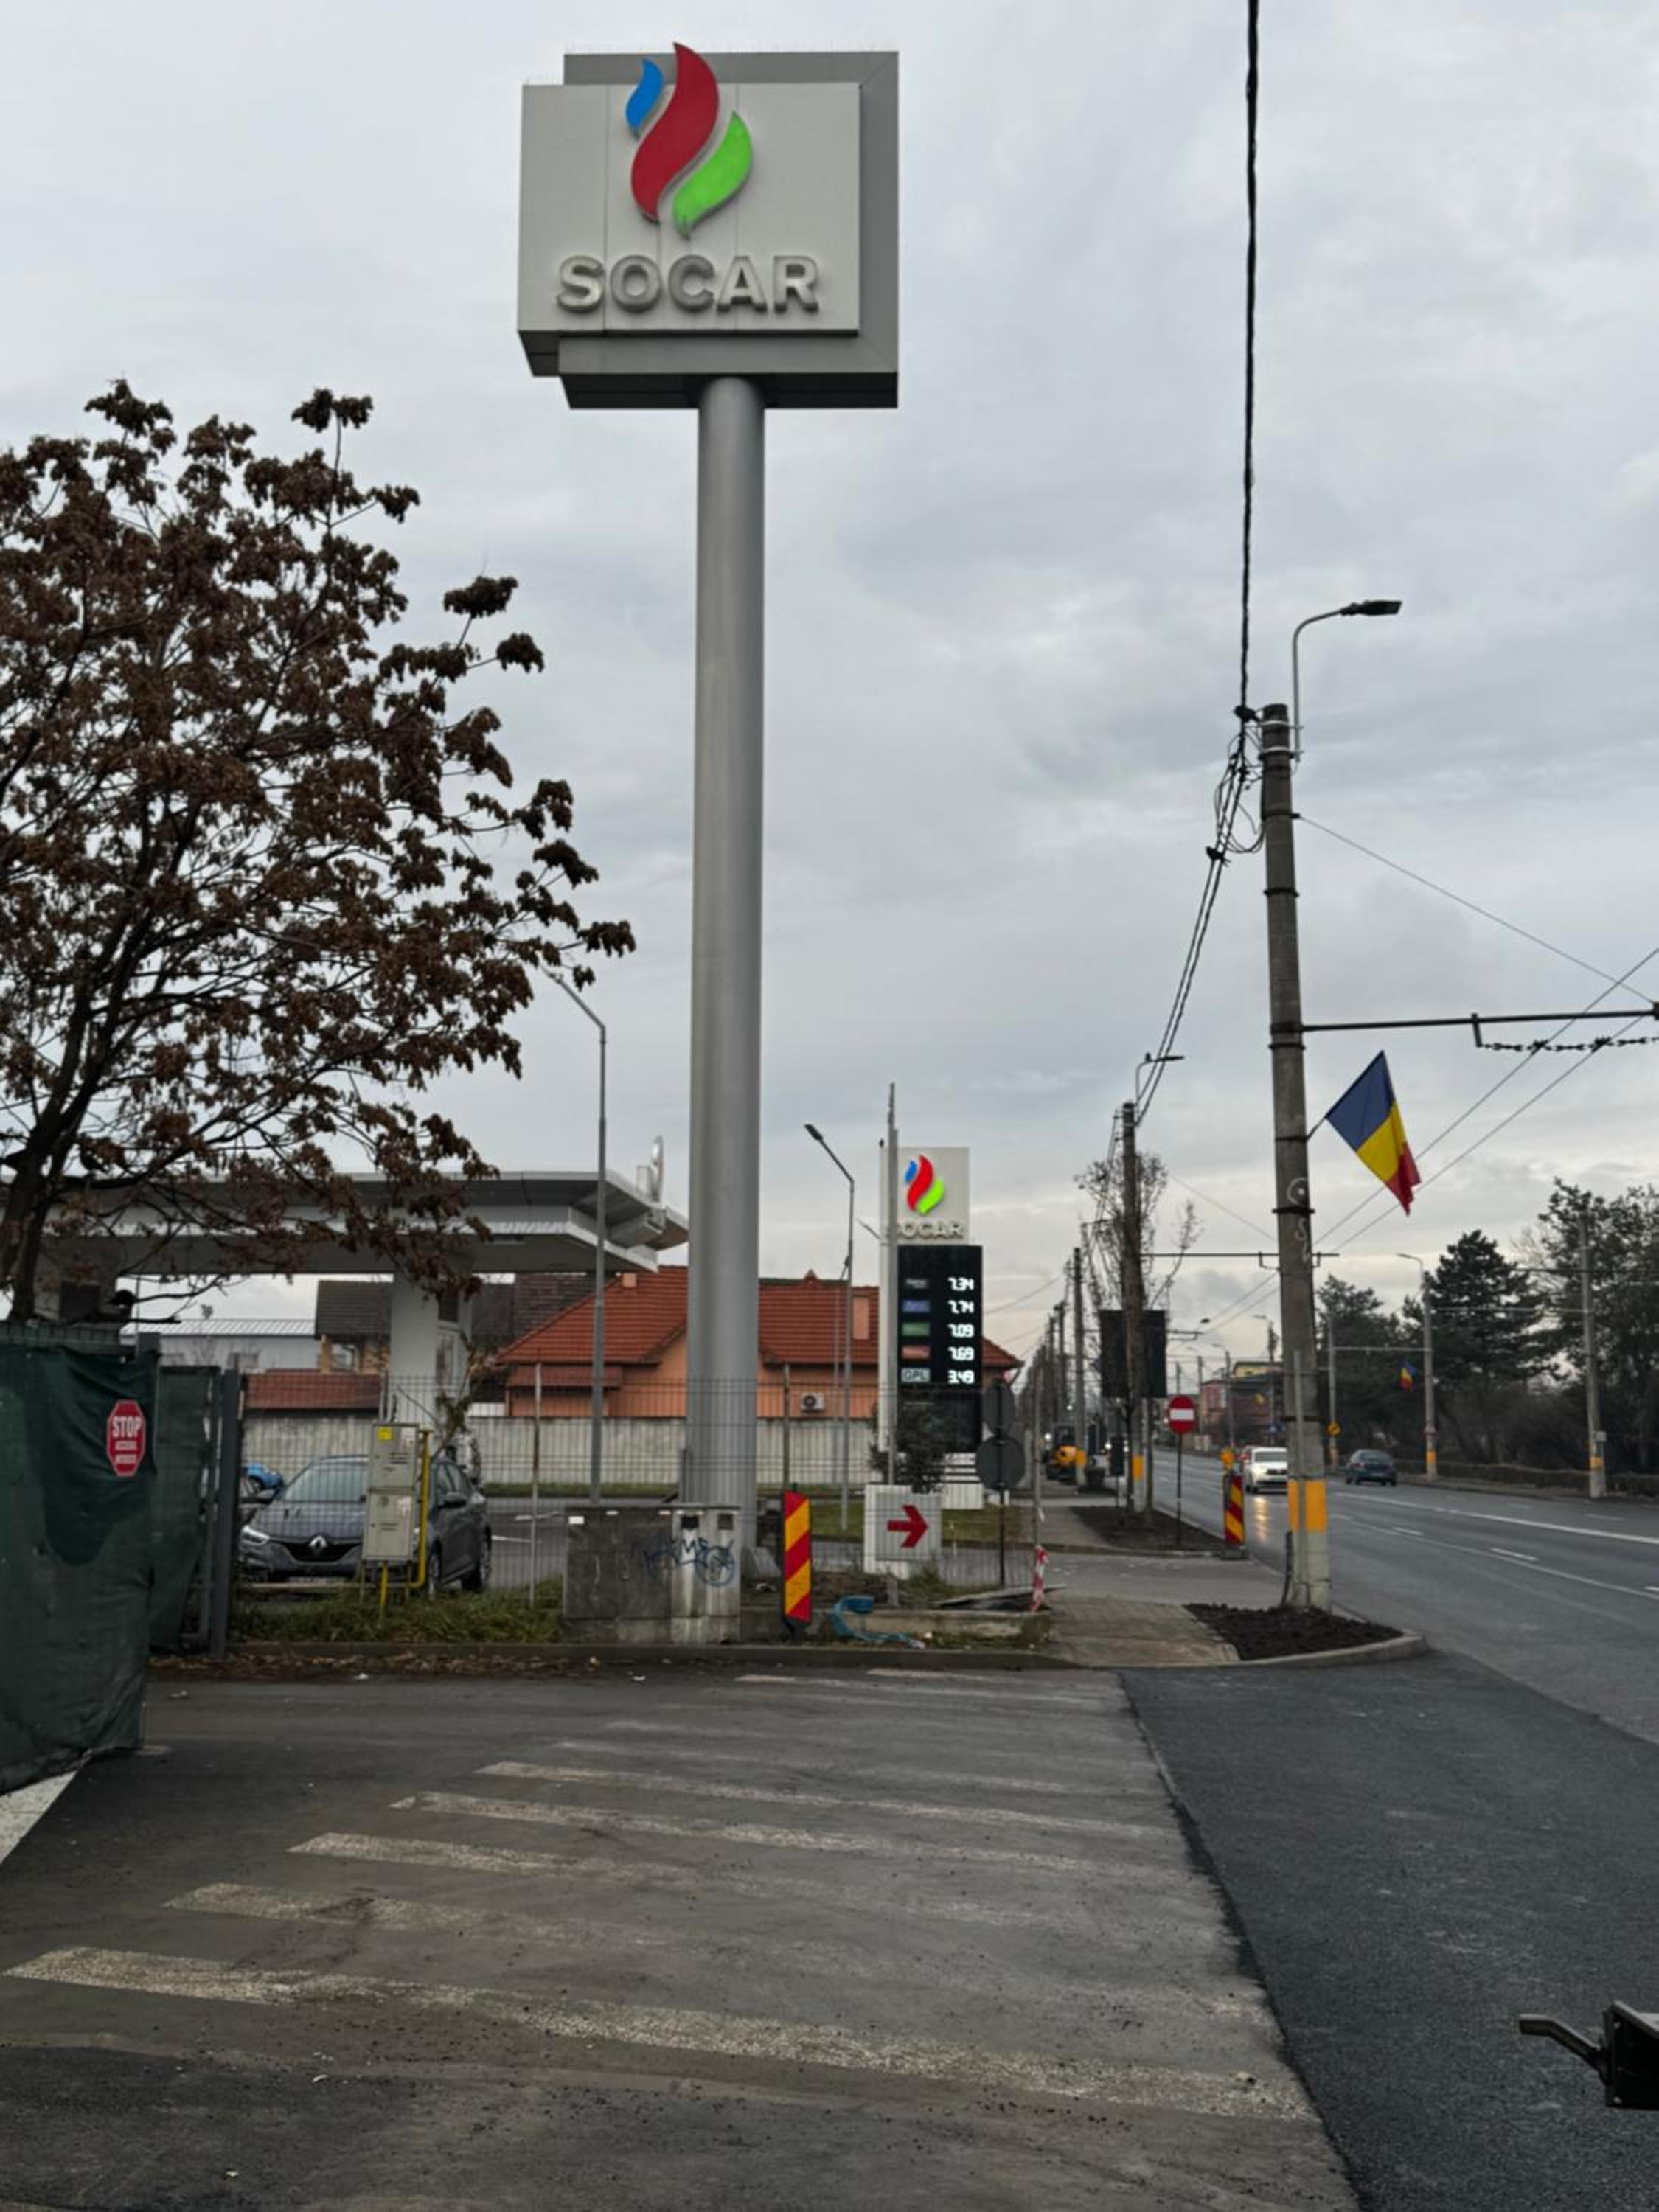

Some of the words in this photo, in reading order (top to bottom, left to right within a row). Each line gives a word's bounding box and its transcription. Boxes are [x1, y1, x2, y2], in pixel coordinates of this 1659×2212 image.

[555, 254, 820, 313] SOCAR
[894, 1220, 964, 1239] OCAR
[903, 1369, 927, 1381] GPL
[112, 1416, 142, 1439] STOP
